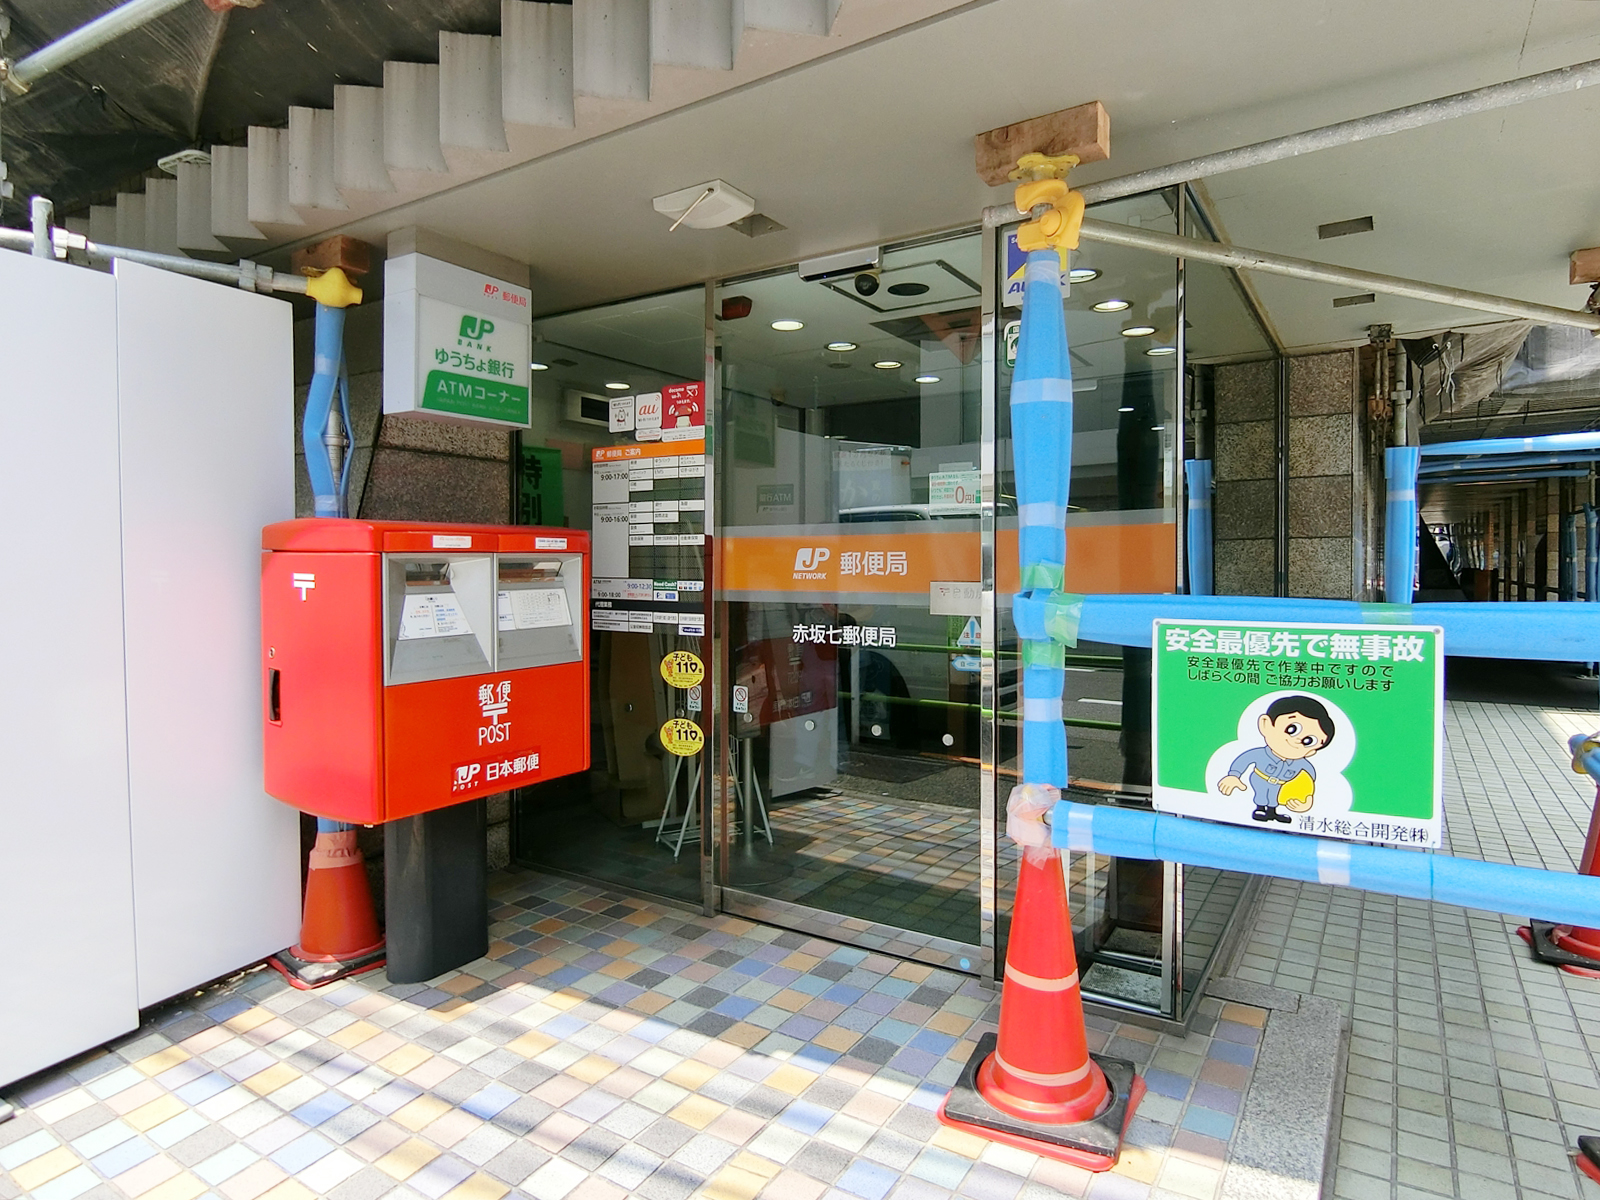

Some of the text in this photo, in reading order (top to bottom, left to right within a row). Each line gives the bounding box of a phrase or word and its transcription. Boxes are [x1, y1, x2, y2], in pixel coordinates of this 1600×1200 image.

[502, 291, 527, 308] 郵便局
[457, 338, 493, 353] BANK
[434, 347, 516, 380] ゆうちょ銀行
[437, 378, 522, 405] ATMコーナー
[638, 404, 660, 416] au
[624, 448, 641, 457] ご案内
[600, 473, 628, 481] 9:00-17:00
[794, 547, 908, 576] JP 郵便局
[792, 572, 827, 580] NETWORK
[792, 623, 897, 648] 赤坂七郵便局
[1165, 627, 1425, 662] 安全最優先で無事故
[673, 653, 693, 662] 子ども
[1187, 656, 1394, 678] 安全最優先で作業中ですので
[1187, 671, 1395, 692] しばらくの間 ご協力お願いします
[478, 680, 512, 706] 郵便
[478, 722, 511, 746] POST
[673, 720, 693, 729] 子ども
[486, 753, 540, 781] 日本郵便
[453, 781, 479, 792] POST
